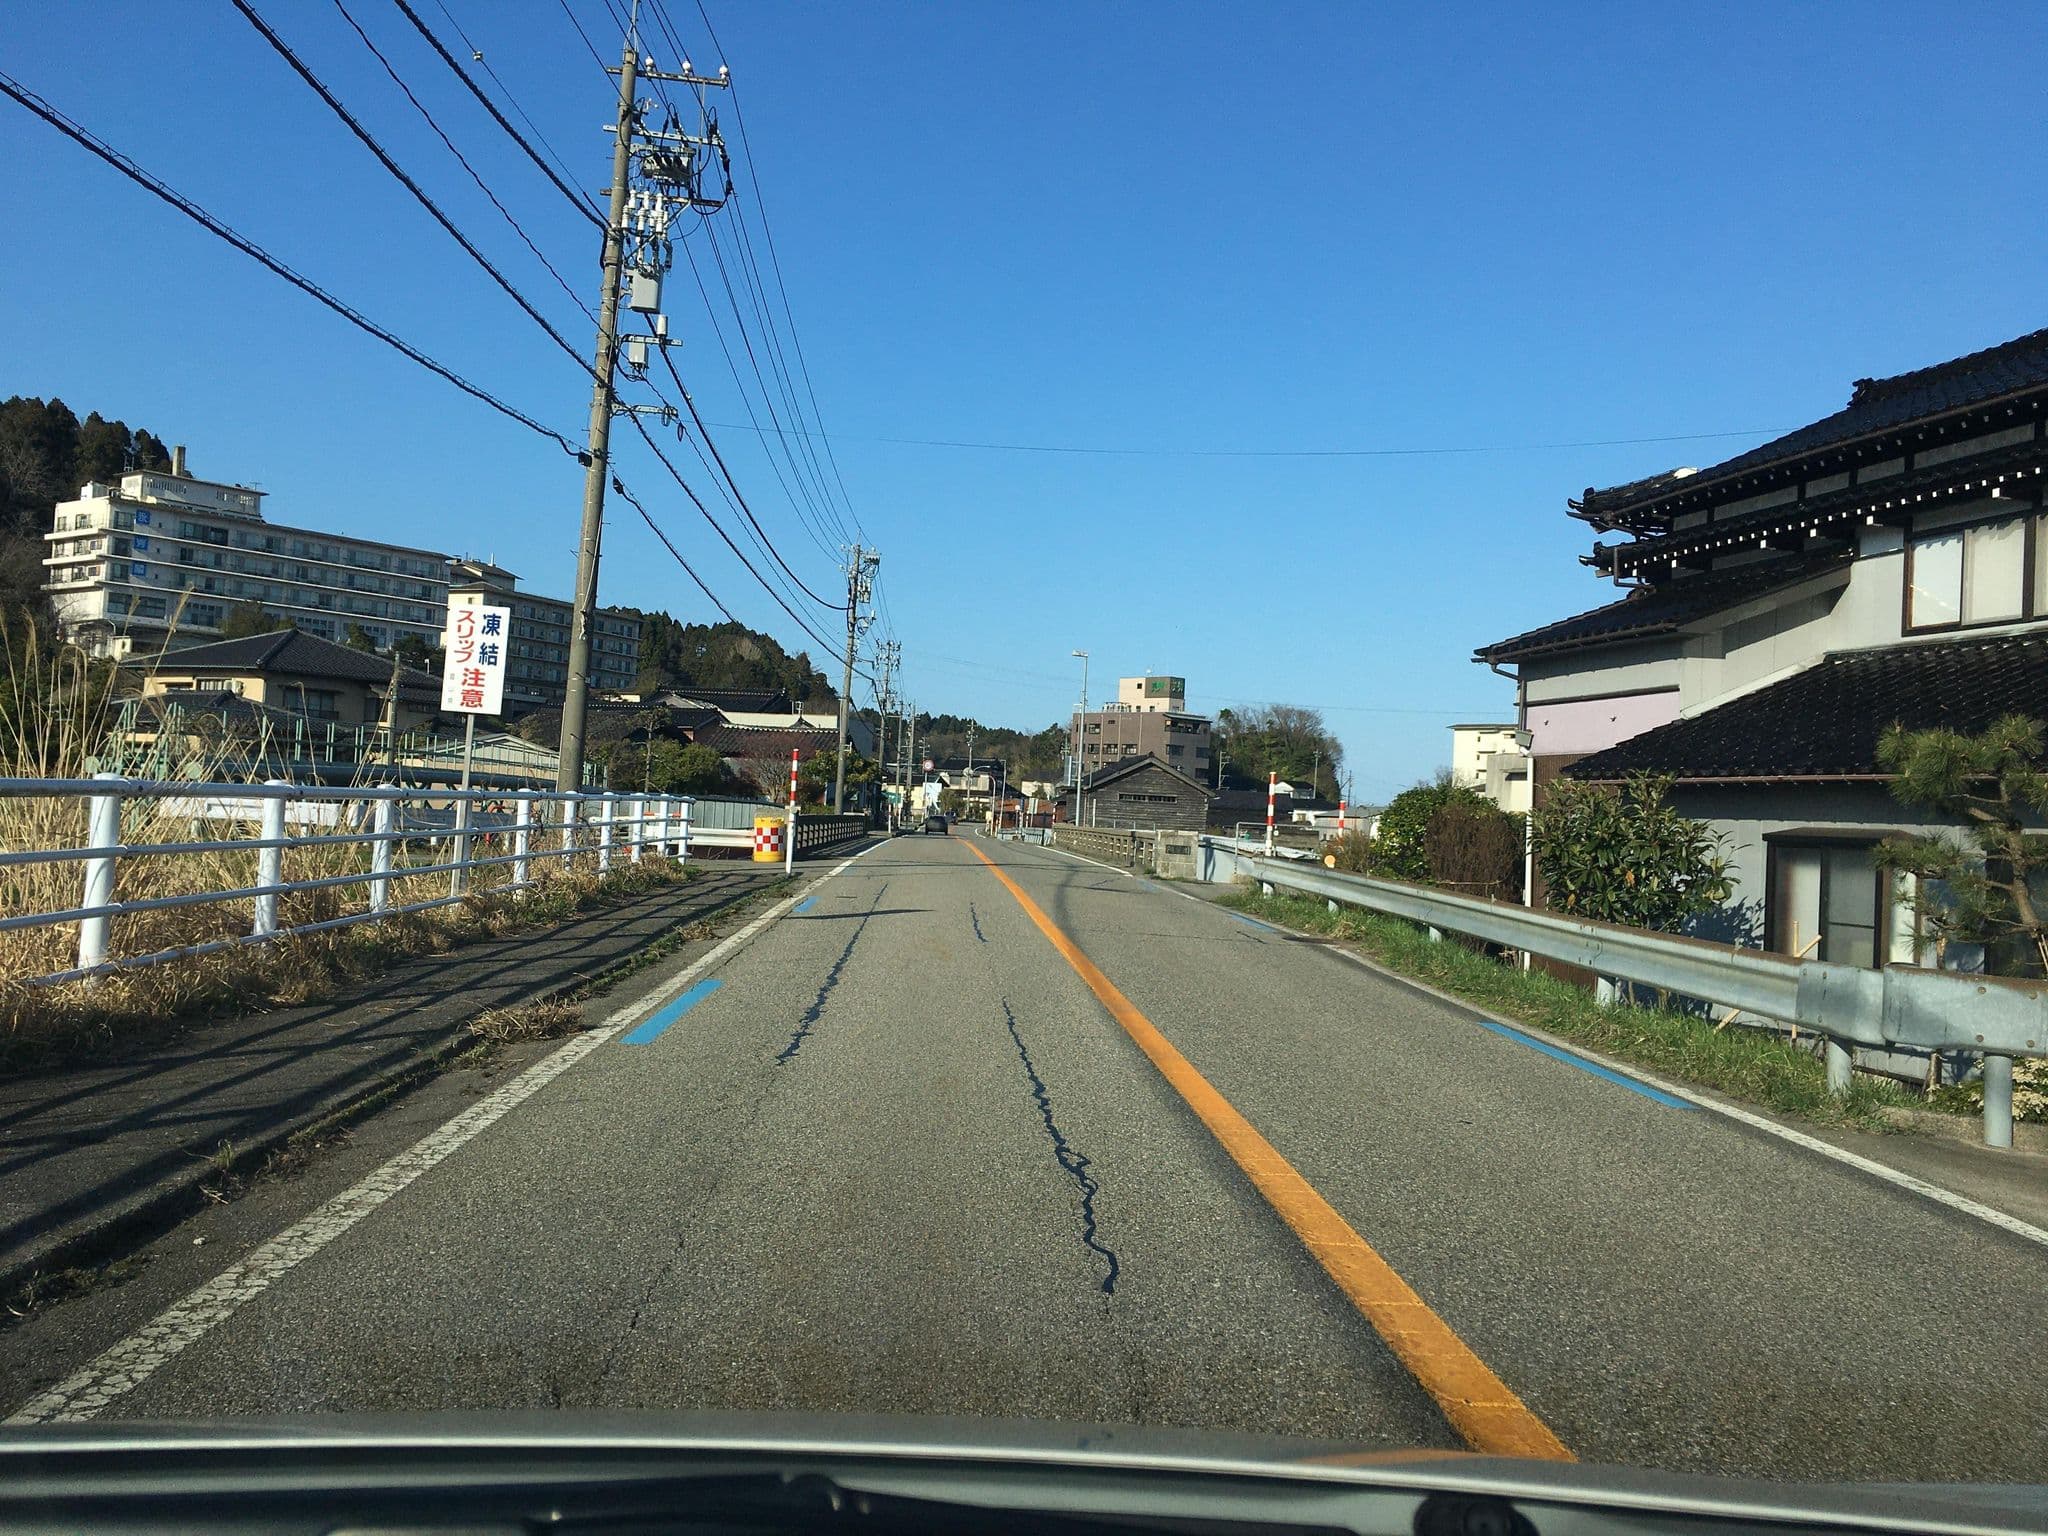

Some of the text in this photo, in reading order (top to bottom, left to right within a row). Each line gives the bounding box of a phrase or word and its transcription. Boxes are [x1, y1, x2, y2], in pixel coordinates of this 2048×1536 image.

[453, 610, 475, 663] スリップ
[478, 613, 502, 666] 凍結
[460, 668, 486, 708] 注意
